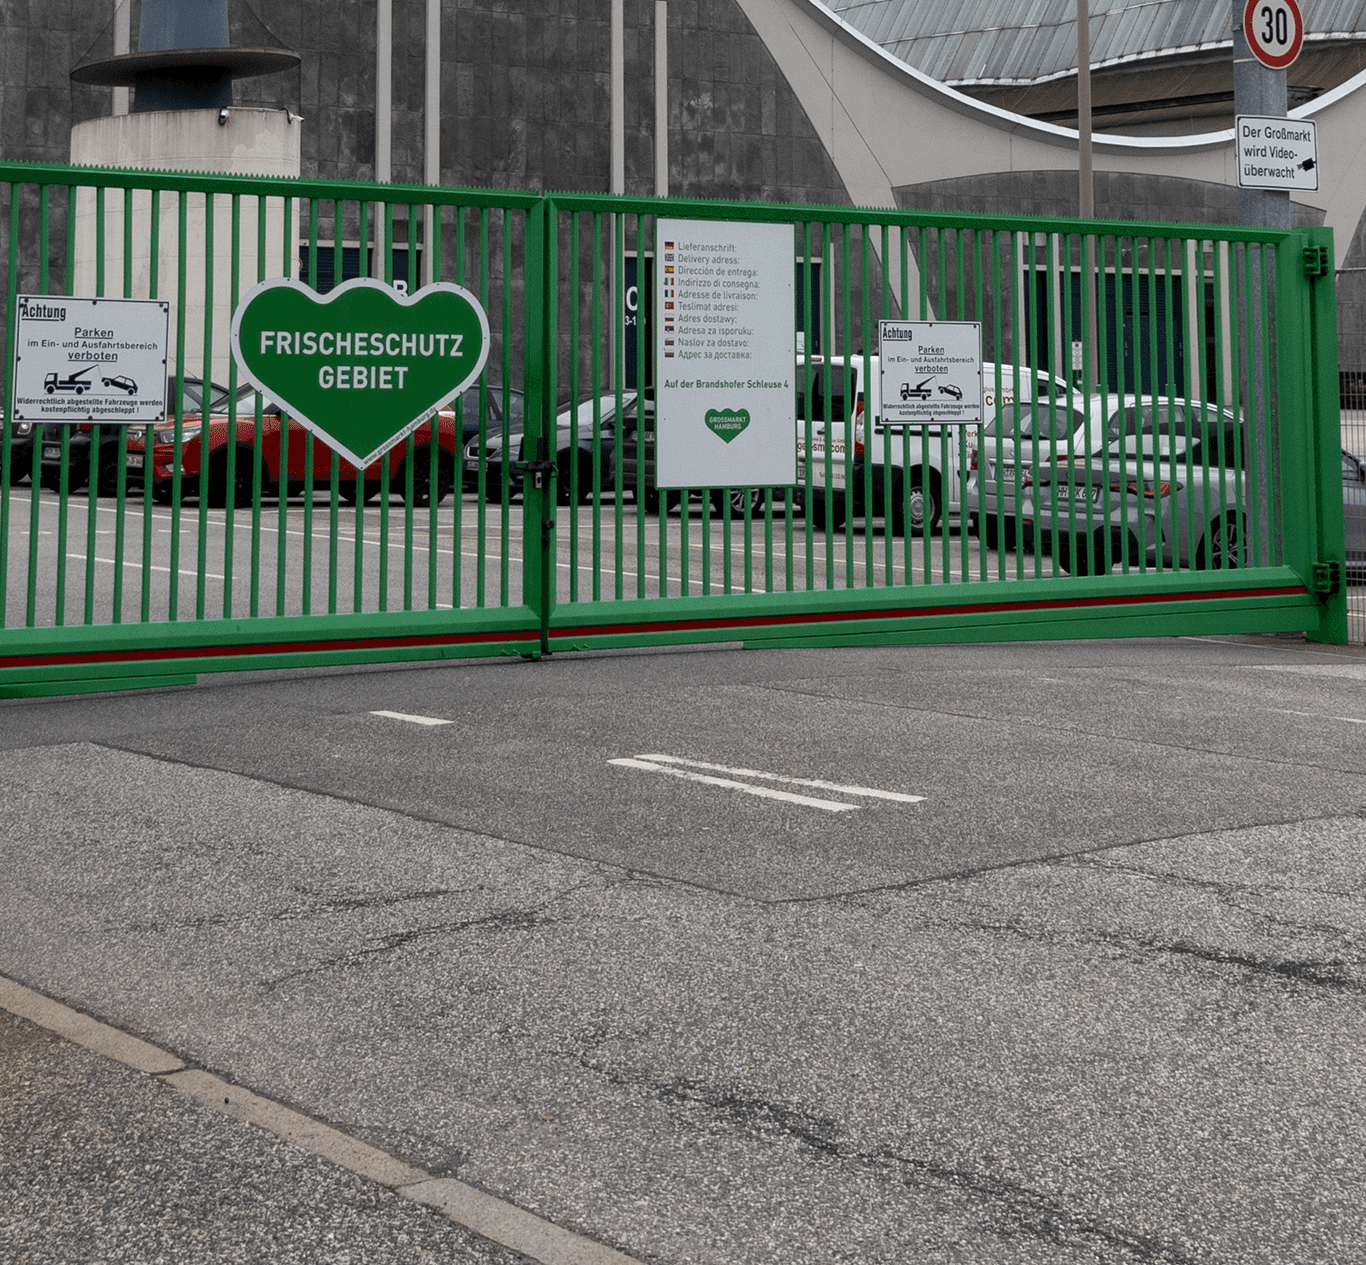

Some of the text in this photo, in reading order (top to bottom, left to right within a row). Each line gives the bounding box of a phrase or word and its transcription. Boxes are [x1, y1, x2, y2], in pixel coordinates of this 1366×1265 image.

[1261, 6, 1288, 45] 30
[1243, 125, 1311, 142] Der Großmarkt
[1243, 146, 1298, 160] wird Video-
[1244, 164, 1295, 179] überwacht
[678, 242, 737, 252] Lieferanschrift:
[678, 254, 740, 265] Delivery adress:
[678, 266, 758, 278] Dirección de entrega:
[678, 278, 760, 290] Indirizzo di consegna:
[678, 290, 758, 300] Adresse de livraison:
[21, 303, 66, 322] Achtung
[678, 302, 739, 312] Teslimat adresi:
[678, 314, 737, 325] Adres dostawy:
[74, 327, 114, 337] Parken
[678, 326, 754, 337] Adresa za isporuku:
[883, 327, 912, 341] Achtung
[27, 339, 158, 350] im Ein- und Ausfahrtsbereich
[260, 331, 464, 357] FRISCHESCHUTZ
[678, 338, 749, 347] Naslov za dostavo:
[918, 345, 945, 353] Parken
[68, 351, 118, 361] verboten
[678, 350, 702, 360] Адрес
[714, 352, 752, 360] доставка:
[318, 366, 409, 389] GEBIET
[664, 380, 789, 388] Auf der Brandshofer Schleuse 4
[17, 397, 65, 405] Widerrechtlich
[66, 398, 104, 406] abgestellte
[104, 398, 138, 406] Fahrzeuge
[40, 406, 90, 414] kostenpflichtig
[92, 406, 135, 414] abgeschleppt
